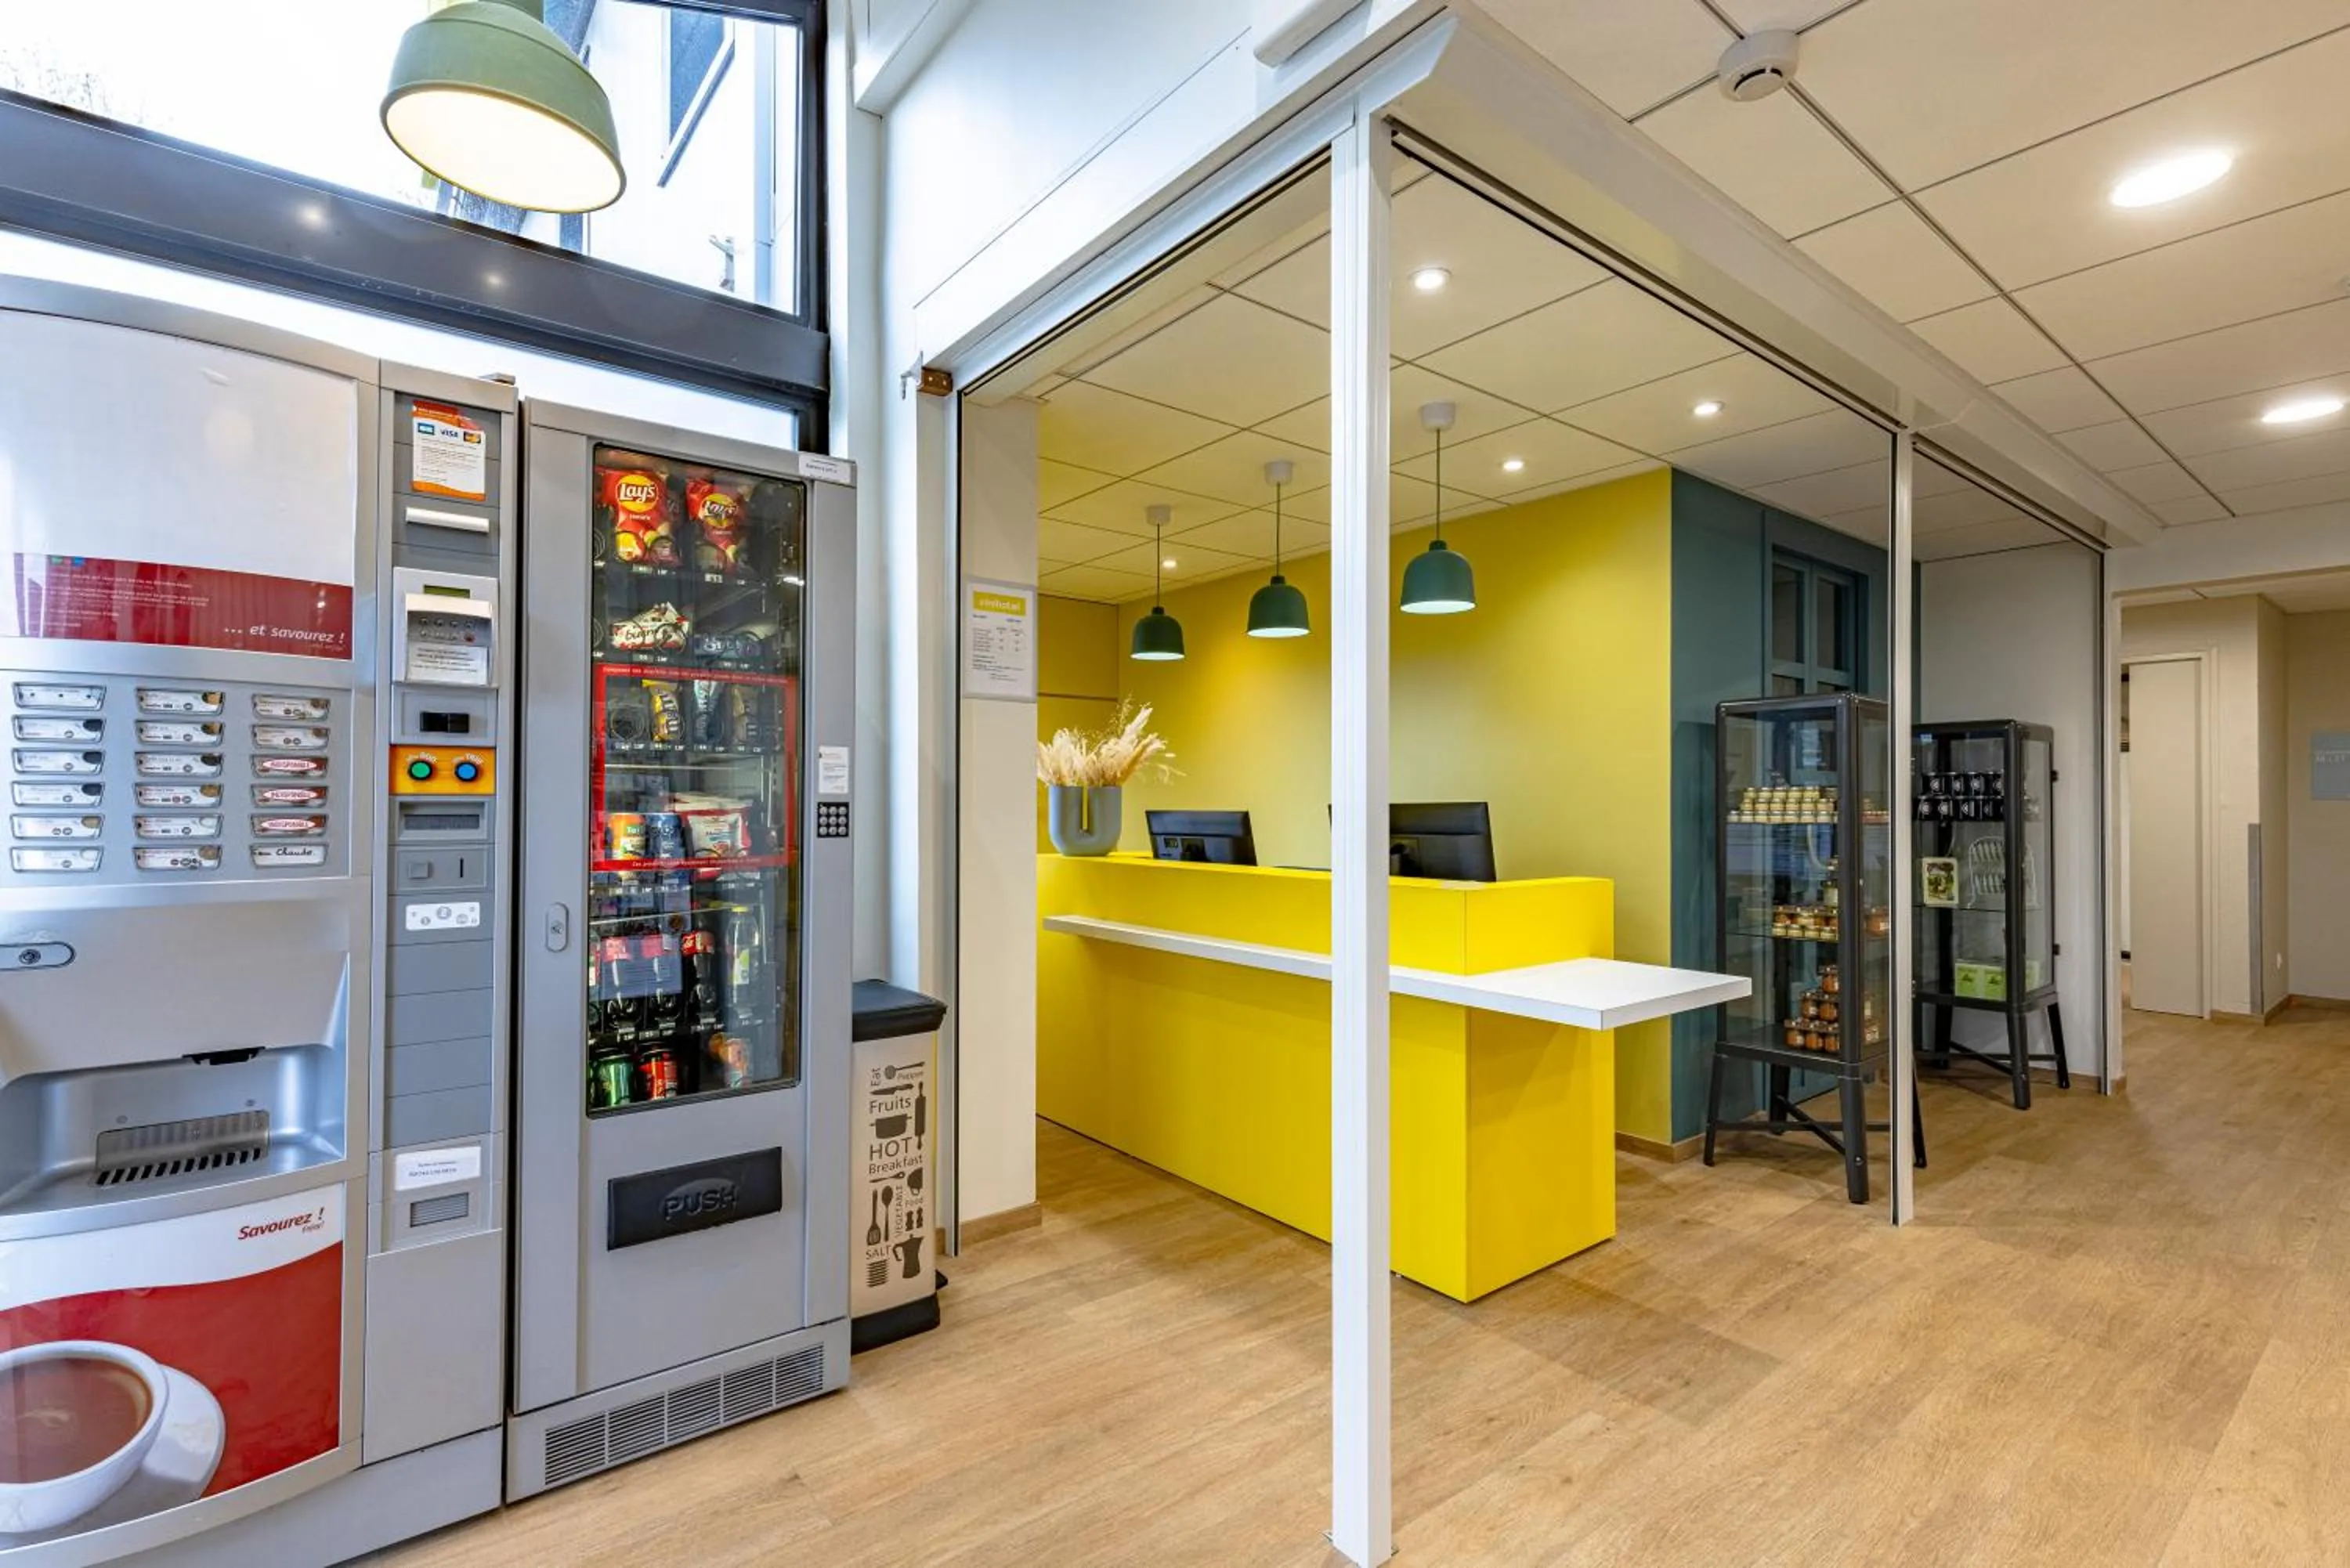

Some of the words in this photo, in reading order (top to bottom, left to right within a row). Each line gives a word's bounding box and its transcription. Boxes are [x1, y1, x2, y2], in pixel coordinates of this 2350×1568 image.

[439, 429, 459, 439] VISA
[250, 625, 266, 636] et
[271, 627, 334, 643] savourez
[870, 1096, 911, 1114] Fruits
[870, 1136, 913, 1162] HOT
[869, 1154, 923, 1174] Breakfast
[664, 1183, 739, 1221] PUSH
[237, 1212, 313, 1240] Savourez
[317, 1206, 325, 1220] !
[866, 1245, 891, 1260] SALT
